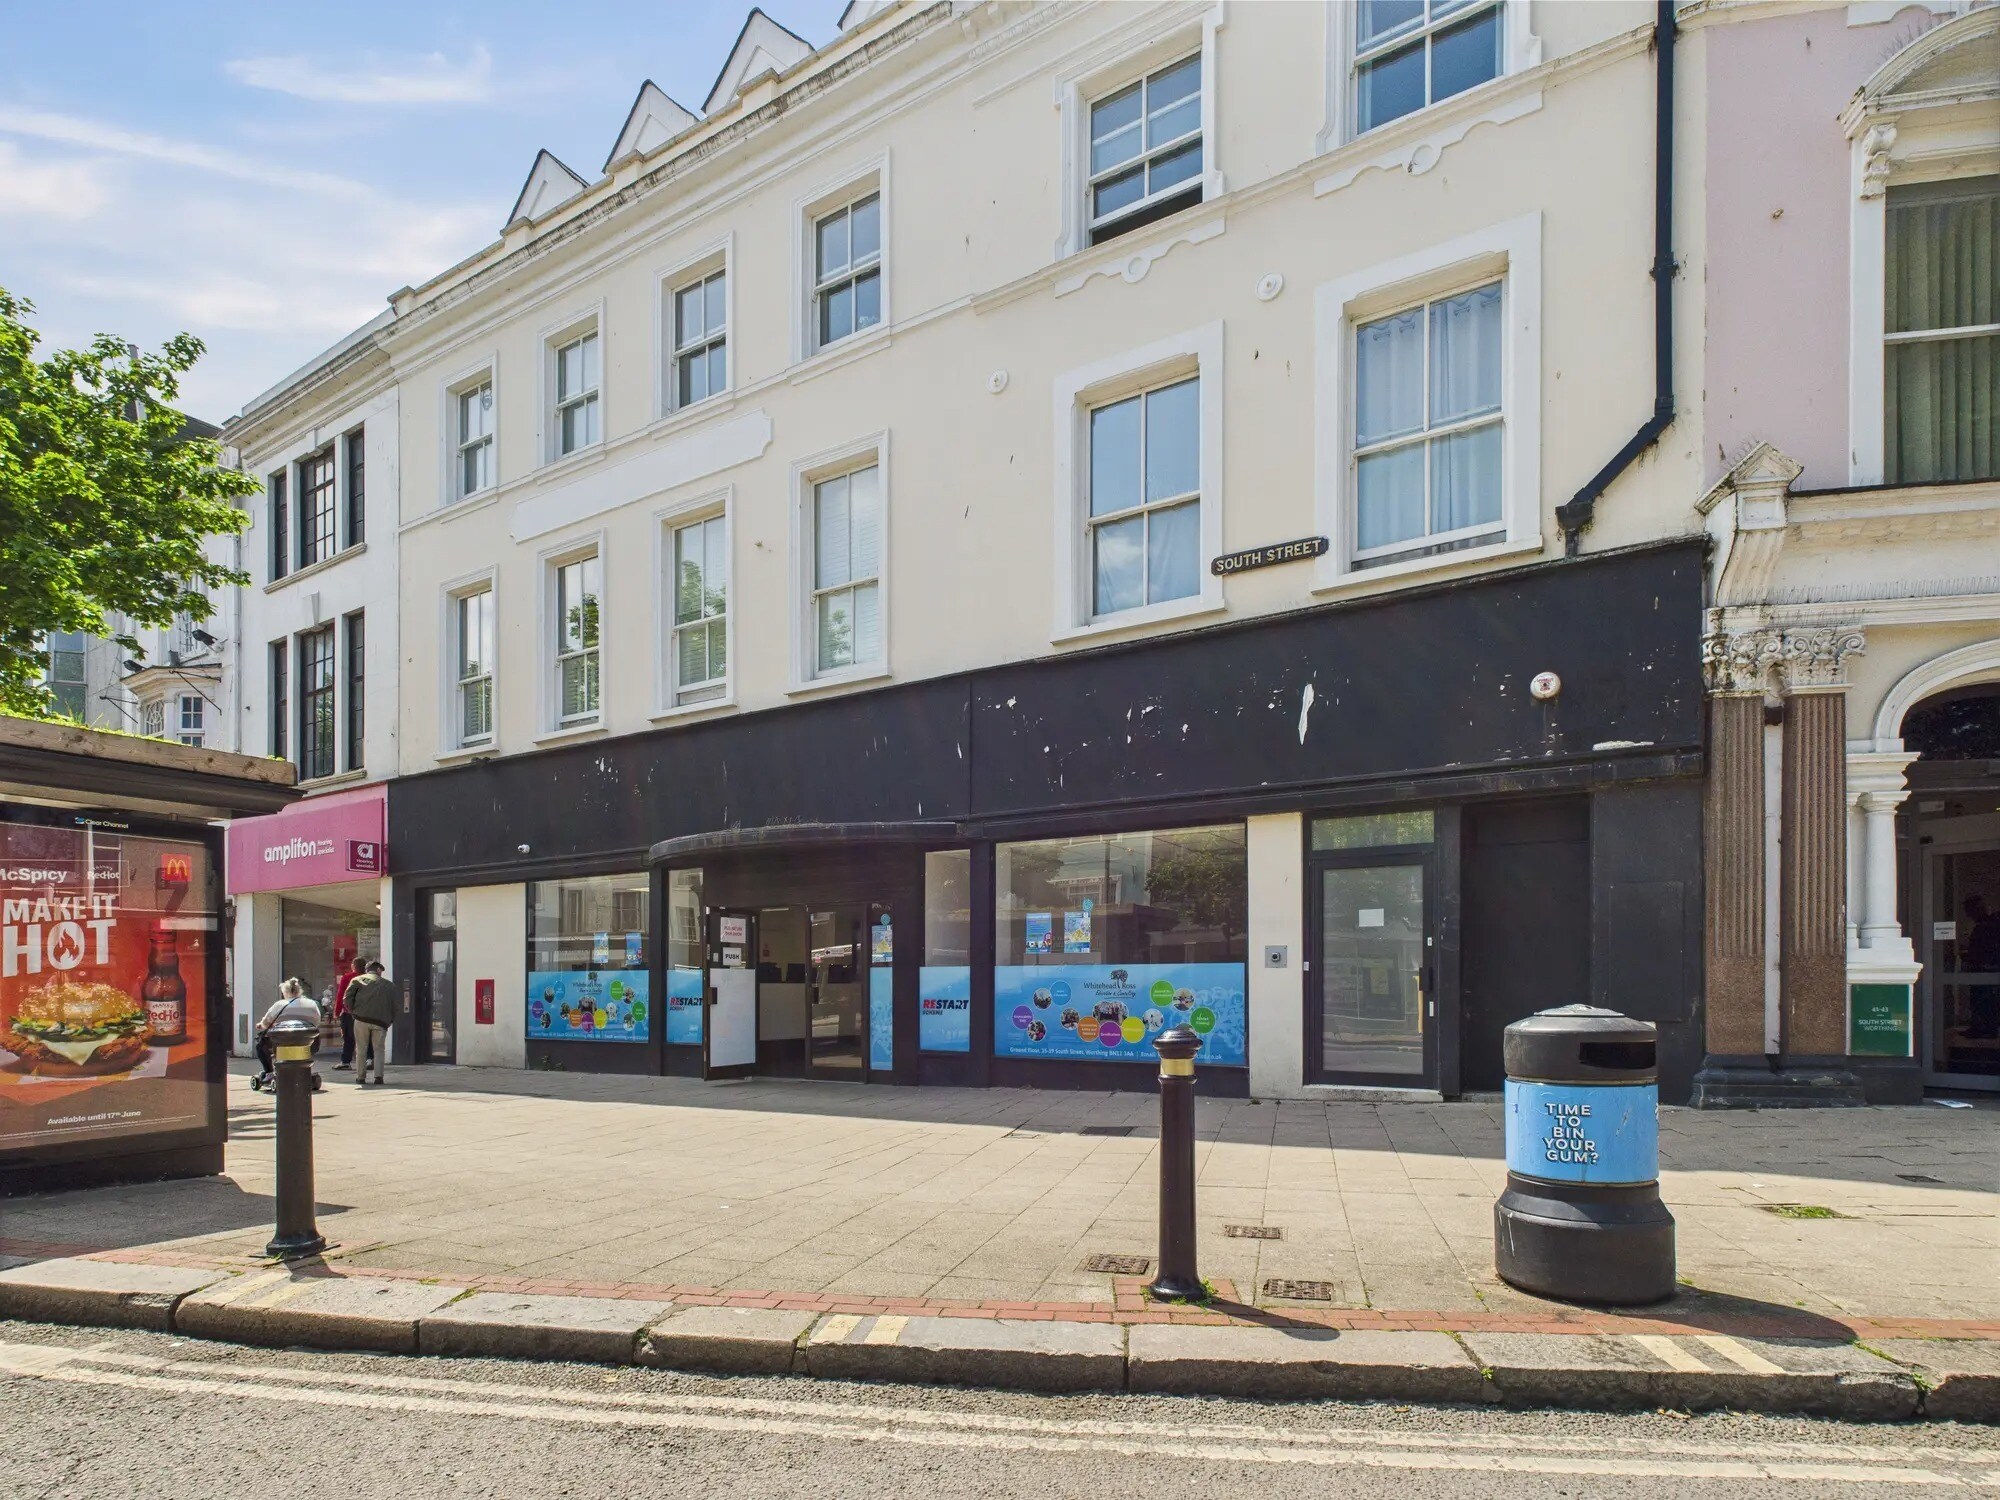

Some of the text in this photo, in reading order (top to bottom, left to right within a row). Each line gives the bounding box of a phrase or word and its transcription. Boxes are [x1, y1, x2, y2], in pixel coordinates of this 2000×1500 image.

[1216, 539, 1321, 571] SOUTH STREET
[85, 818, 129, 829] Clear Channel
[264, 837, 316, 866] amplifon
[3, 895, 116, 924] MAKE IT
[2, 919, 117, 978] HOT
[1083, 982, 1117, 990] Whitehead
[669, 997, 703, 1006] RESTART
[923, 999, 969, 1010] RESTART
[1545, 1102, 1592, 1117] TIME
[47, 1115, 86, 1125] Available
[87, 1112, 106, 1121] until
[121, 1110, 142, 1118] June
[1554, 1115, 1581, 1128] TO
[1552, 1126, 1586, 1140] BIN
[1542, 1137, 1596, 1152] YOUR
[1546, 1149, 1600, 1165] GUM?
